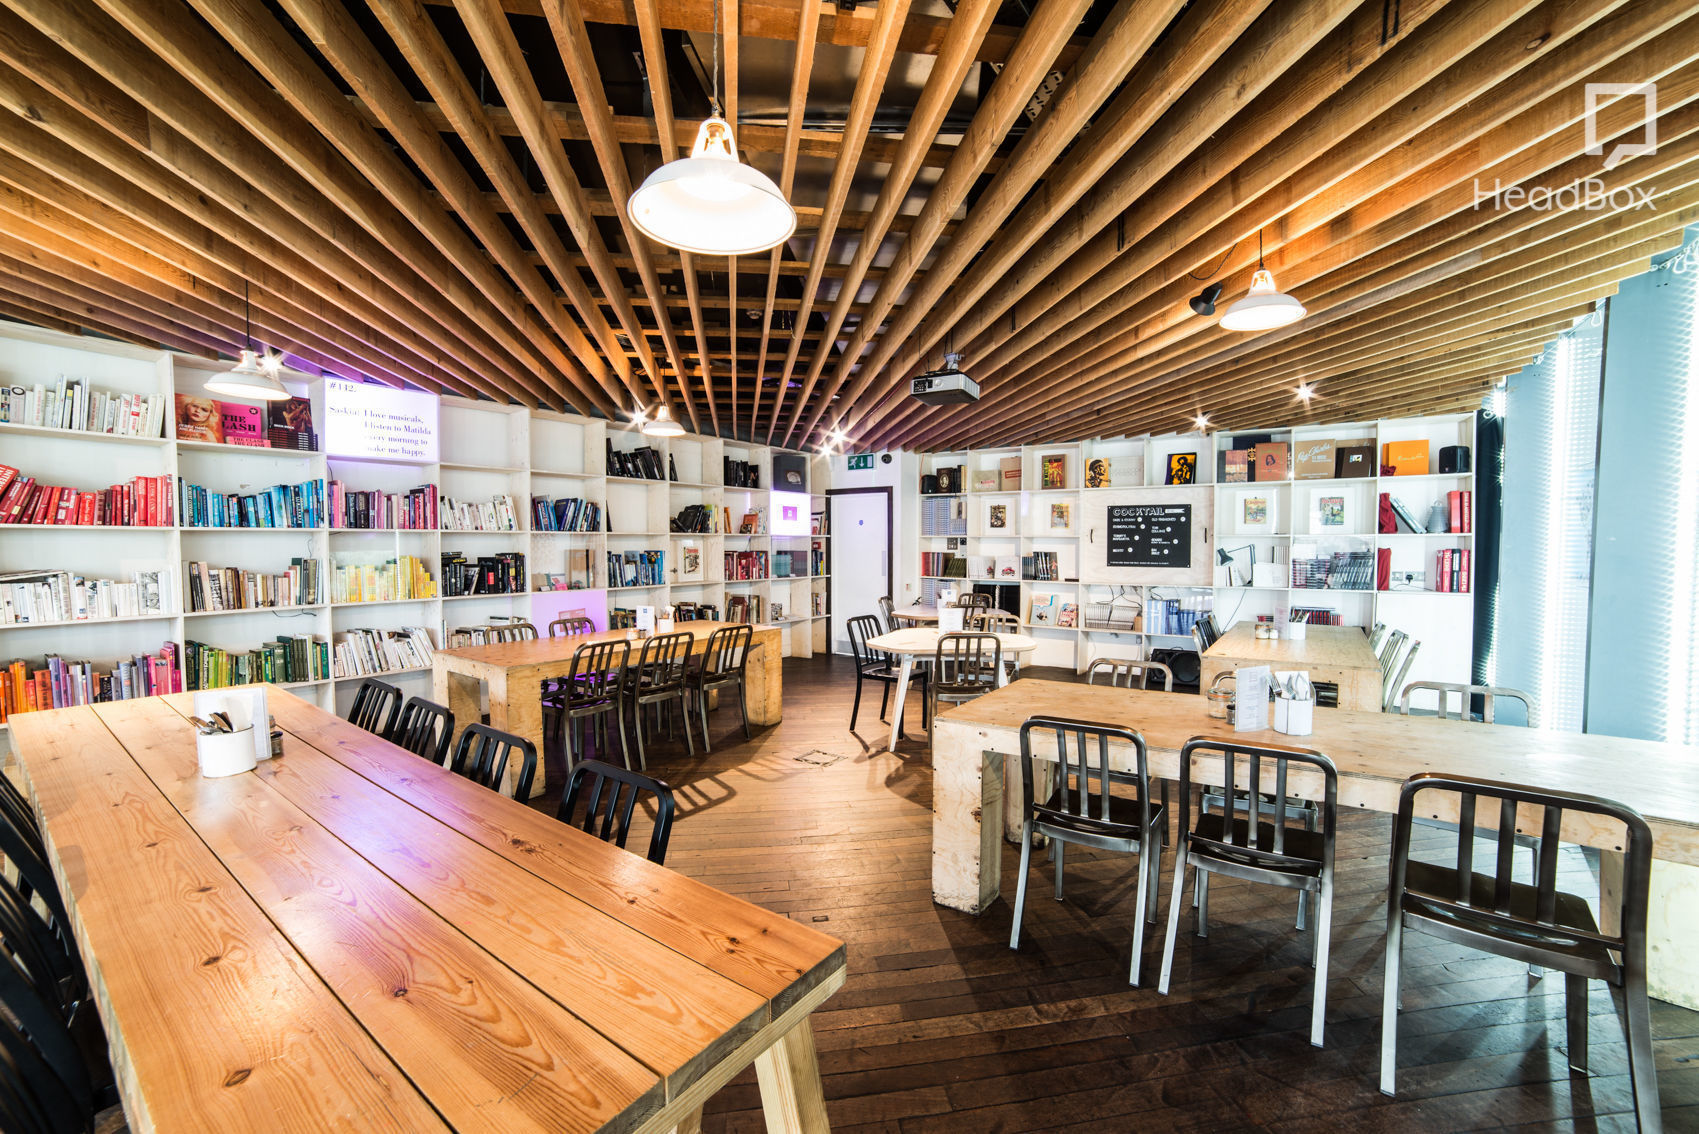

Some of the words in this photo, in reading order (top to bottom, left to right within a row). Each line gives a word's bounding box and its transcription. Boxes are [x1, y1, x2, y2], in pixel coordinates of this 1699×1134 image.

[222, 414, 247, 424] THE
[370, 410, 387, 419] love
[389, 415, 424, 424] musicals,
[222, 421, 257, 432] LASH
[370, 421, 392, 432] listen
[403, 425, 431, 435] Matilda
[388, 436, 419, 445] morning
[401, 446, 426, 457] happy.
[1112, 507, 1165, 517] COCKTAIL
